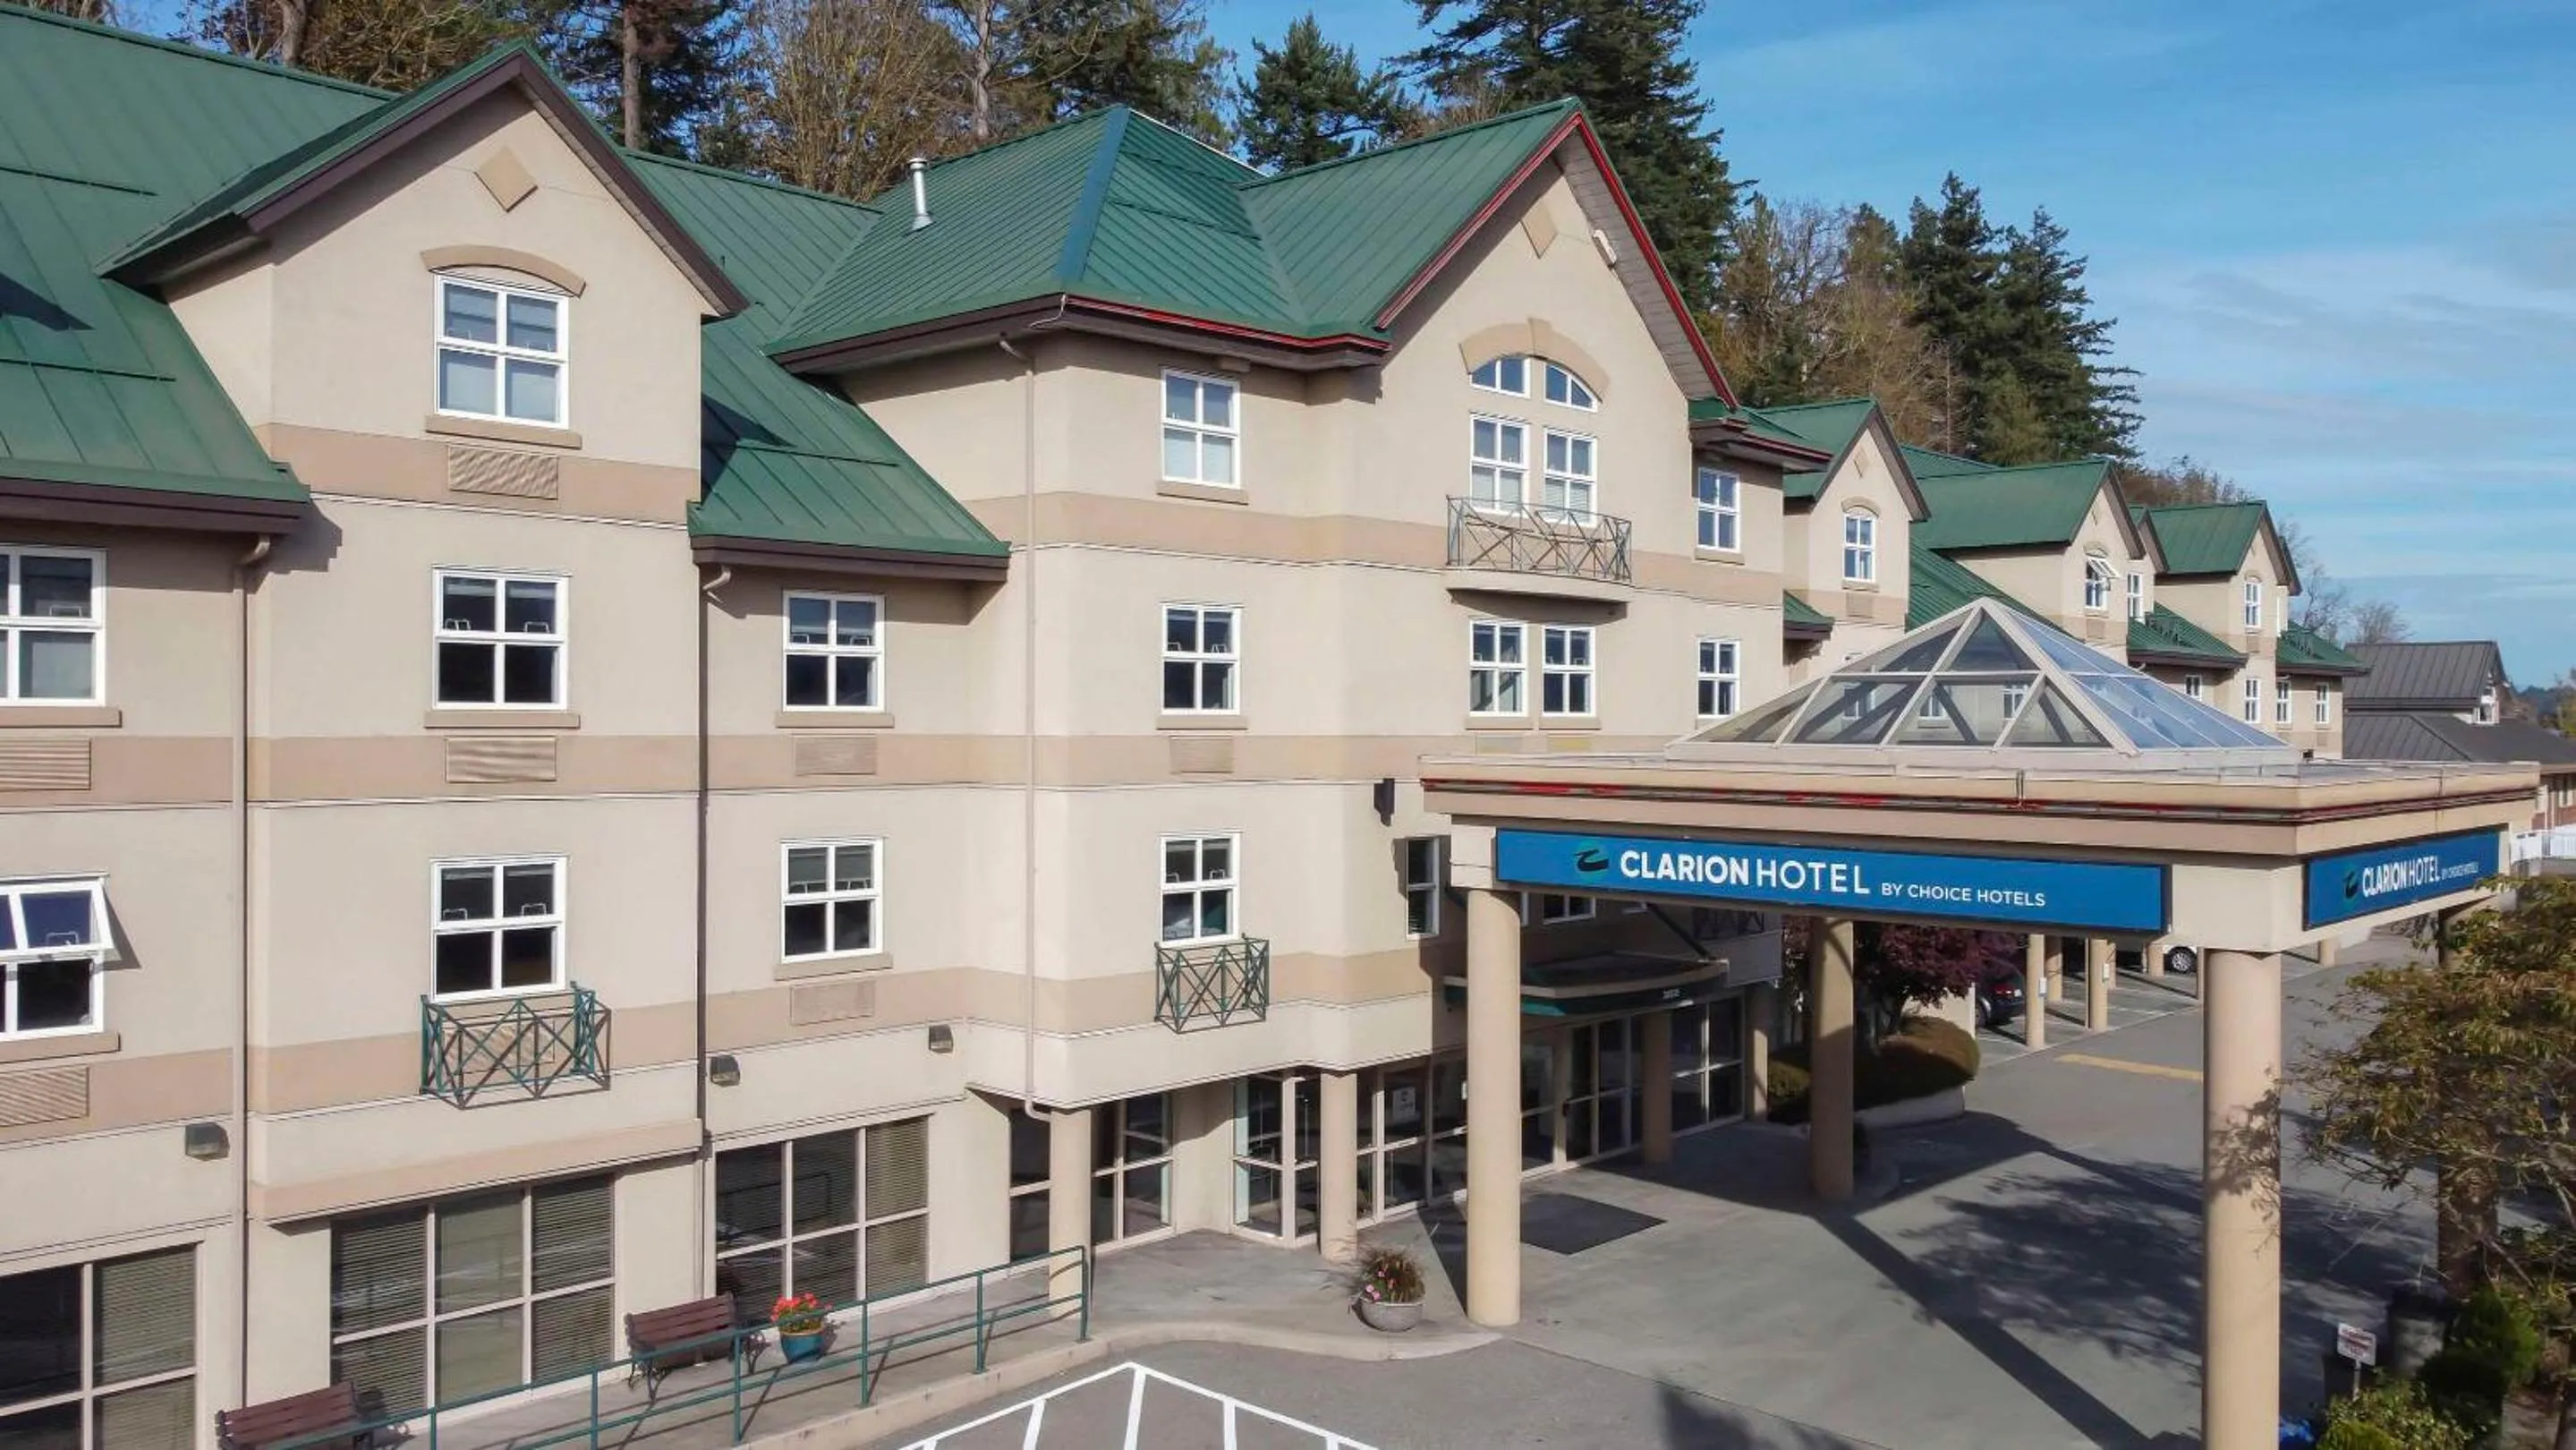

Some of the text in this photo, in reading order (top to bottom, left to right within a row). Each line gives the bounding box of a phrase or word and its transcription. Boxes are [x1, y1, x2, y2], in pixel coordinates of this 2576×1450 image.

[1620, 849, 2045, 907] CLARION HOTEL BY CHOICE HOTELS
[2363, 863, 2407, 897] CLARION
[2409, 856, 2440, 886] HOTEL
